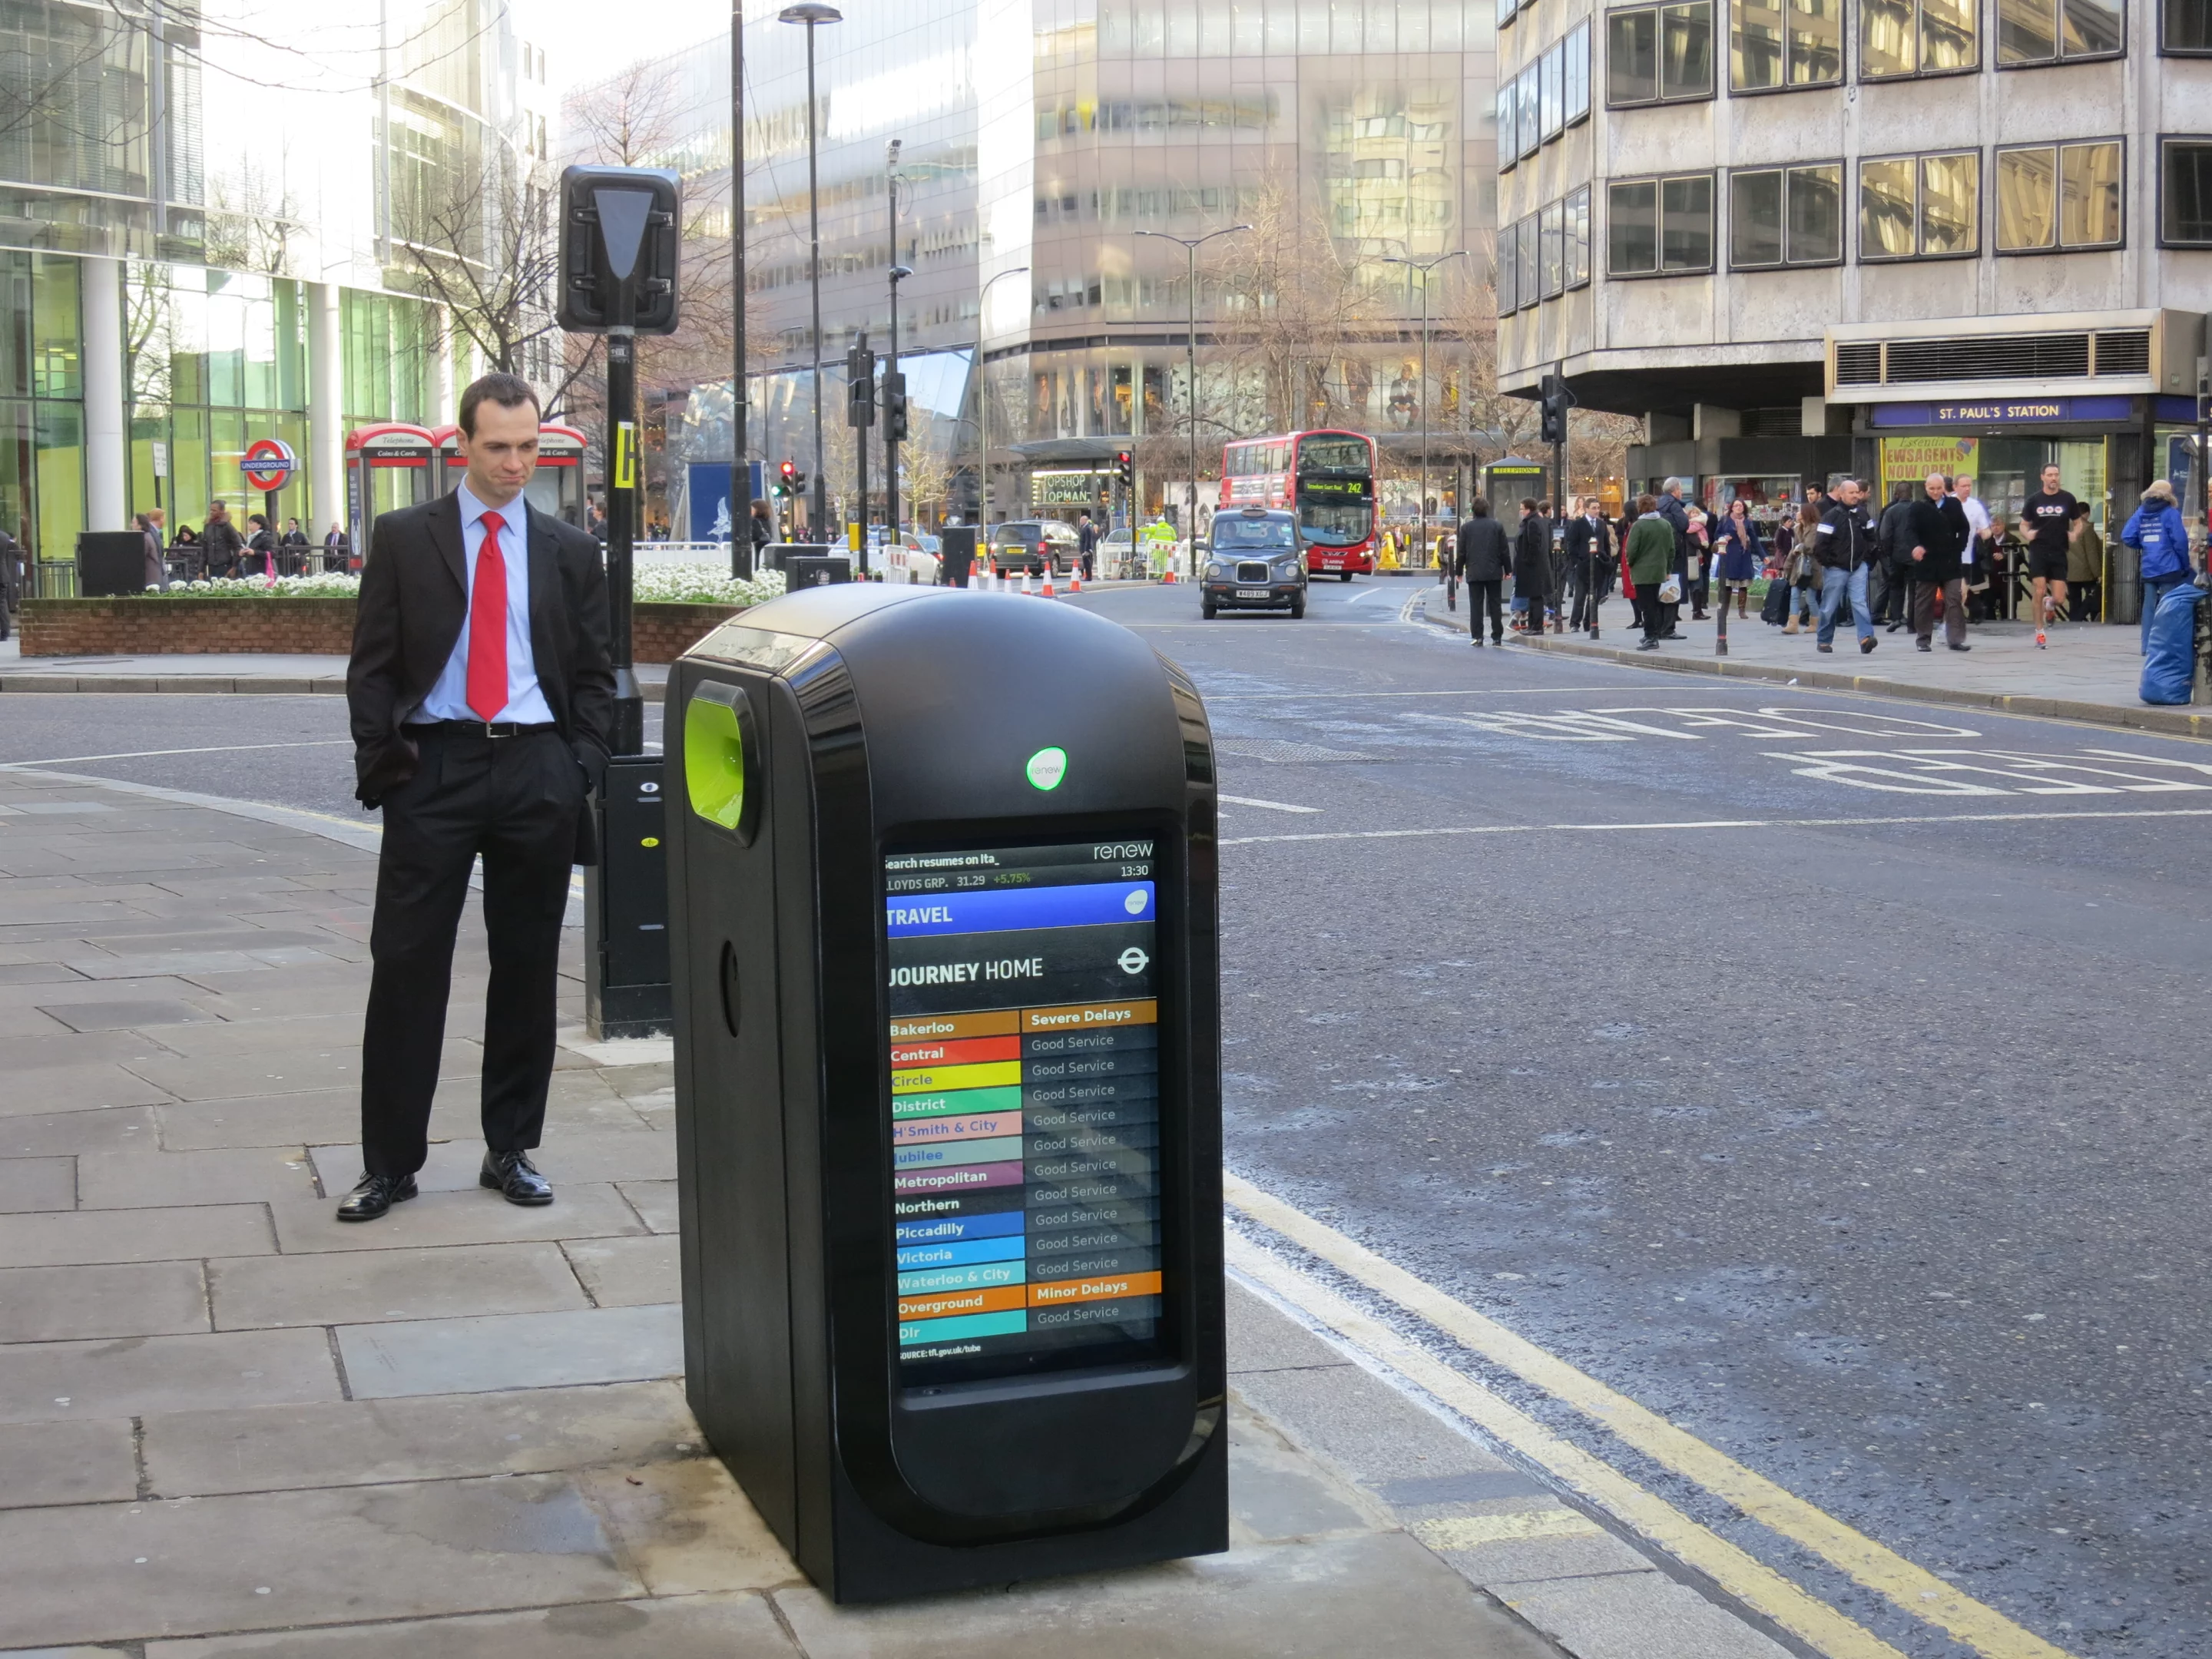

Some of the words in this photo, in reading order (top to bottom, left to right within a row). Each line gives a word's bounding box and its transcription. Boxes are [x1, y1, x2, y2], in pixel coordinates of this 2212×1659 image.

[1939, 408, 1956, 419] ST.
[1960, 406, 2001, 419] PAUL'S
[2007, 405, 2059, 417] STATION
[382, 436, 415, 445] Telephone
[1886, 448, 1964, 462] EWSAGENTS
[1888, 465, 1917, 478] NOW
[1921, 464, 1955, 478] OPEN
[1044, 475, 1086, 487] TOPSHOP
[1347, 482, 1362, 493] 242
[1374, 481, 1419, 491] PMAN
[1044, 491, 1087, 502] TOPMAN
[1031, 767, 1061, 775] renew
[1094, 843, 1154, 859] renew
[886, 857, 918, 869] earch
[919, 856, 964, 868] resumes
[965, 856, 979, 865] on
[1121, 865, 1149, 876] 13:30
[886, 879, 922, 891] LOYDS
[924, 877, 949, 889] GRP.
[956, 875, 985, 886] 31.29
[993, 873, 1031, 884] +5.75%
[886, 906, 953, 926] TRAVEL
[889, 962, 980, 987] JOURNEY
[985, 957, 1044, 980] HOME
[1031, 1013, 1081, 1026] Severe
[1084, 1008, 1131, 1022] Delays
[890, 1022, 955, 1036] Bakerloo
[1031, 1038, 1064, 1051] Good
[1068, 1035, 1114, 1048] Service
[890, 1047, 944, 1061] Central
[1032, 1062, 1065, 1076] Good
[1068, 1059, 1114, 1073] Service
[892, 1074, 933, 1088] Circle
[1033, 1088, 1065, 1101] Good
[1069, 1084, 1115, 1098] Service
[892, 1098, 946, 1113] District
[1033, 1112, 1066, 1126] Good
[1069, 1109, 1116, 1123] Service
[893, 1123, 949, 1138] H'Smith
[954, 1122, 965, 1134] &
[969, 1120, 998, 1132] City
[1034, 1137, 1066, 1151] Good
[1070, 1134, 1116, 1148] Service
[894, 1150, 943, 1164] Jubilee
[1035, 1162, 1067, 1176] Good
[1071, 1159, 1117, 1173] Service
[895, 1171, 987, 1190] Metropolitan
[1035, 1187, 1067, 1200] Good
[1071, 1184, 1117, 1197] Service
[895, 1199, 960, 1214] Northern
[1035, 1212, 1068, 1225] Good
[1071, 1208, 1118, 1223] Service
[896, 1222, 965, 1240] Piccadilly
[1036, 1237, 1068, 1250] Good
[1072, 1233, 1118, 1247] Service
[897, 1249, 953, 1264] Victoria
[1037, 1261, 1069, 1275] Good
[1072, 1258, 1118, 1272] Service
[898, 1273, 963, 1291] Waterloo
[967, 1271, 978, 1282] &
[982, 1268, 1011, 1281] City
[1037, 1286, 1078, 1300] Minor
[1081, 1281, 1128, 1296] Delays
[899, 1295, 983, 1314] Overground
[1038, 1310, 1070, 1324] Good
[1074, 1306, 1119, 1321] Service
[899, 1327, 920, 1339] Dlr
[929, 1344, 982, 1358] tfl.gov.uk/tube
